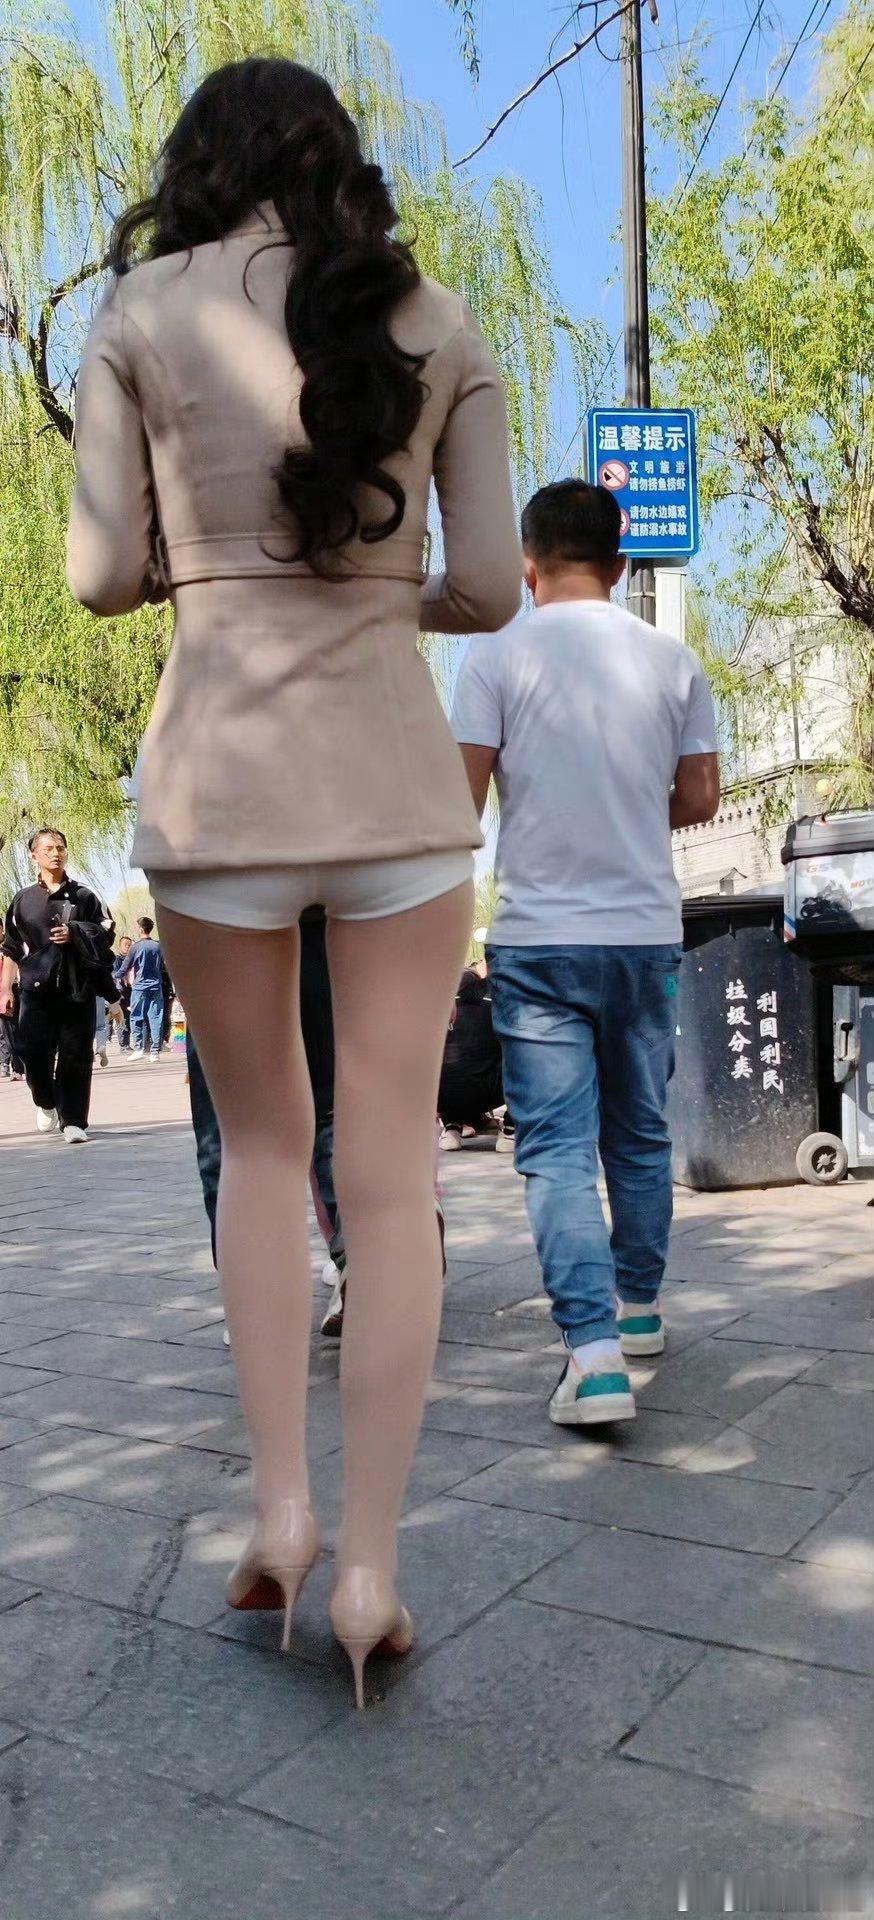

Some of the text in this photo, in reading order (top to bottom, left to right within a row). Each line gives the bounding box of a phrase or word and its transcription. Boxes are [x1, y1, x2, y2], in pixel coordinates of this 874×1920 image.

[599, 425, 686, 451] 温馨提示
[629, 460, 686, 474] 文明旅游
[629, 477, 686, 491] 请勿捞鱼捞虾
[630, 505, 687, 519] 请勿水边嬉戏
[630, 522, 687, 536] 谨防溺水事故
[725, 979, 754, 1080] 垃圾分类
[756, 991, 784, 1094] 利国利民
